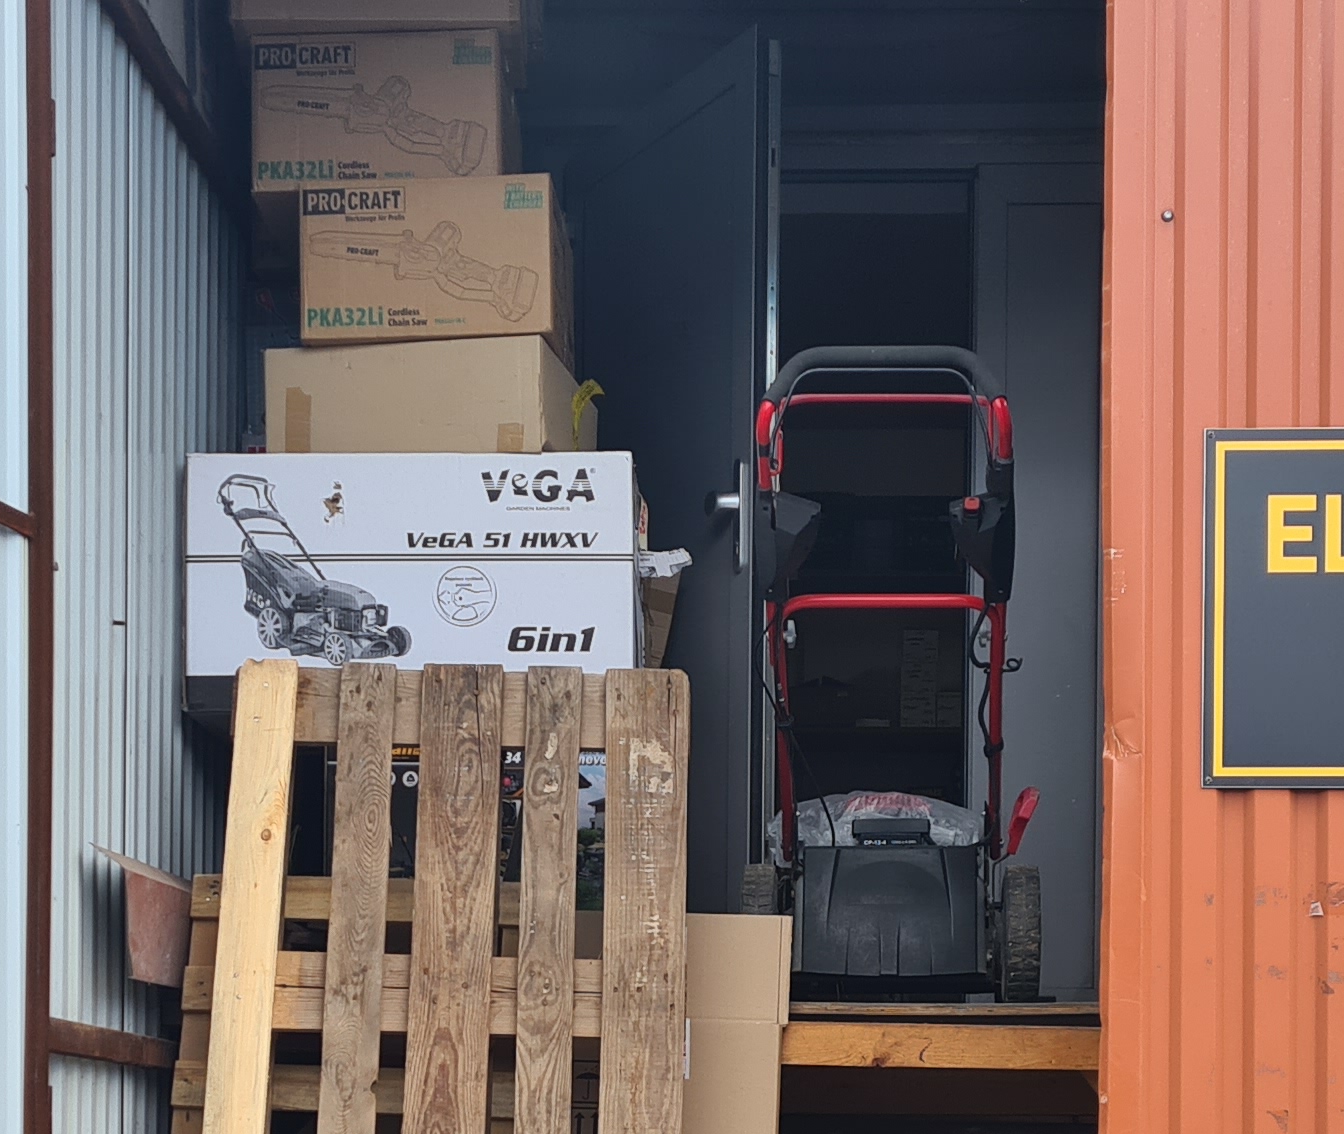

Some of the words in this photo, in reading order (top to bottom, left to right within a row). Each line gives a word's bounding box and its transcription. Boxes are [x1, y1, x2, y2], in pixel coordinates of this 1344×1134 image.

[258, 160, 334, 181] PKA32Li
[338, 171, 360, 180] Chain
[307, 305, 383, 328] PKA32Li
[388, 308, 420, 317] Cordless
[388, 318, 410, 327] Chain
[411, 318, 428, 326] Saw
[407, 532, 473, 548] VeGA
[520, 532, 599, 549] HWXV
[507, 626, 596, 653] 6in1
